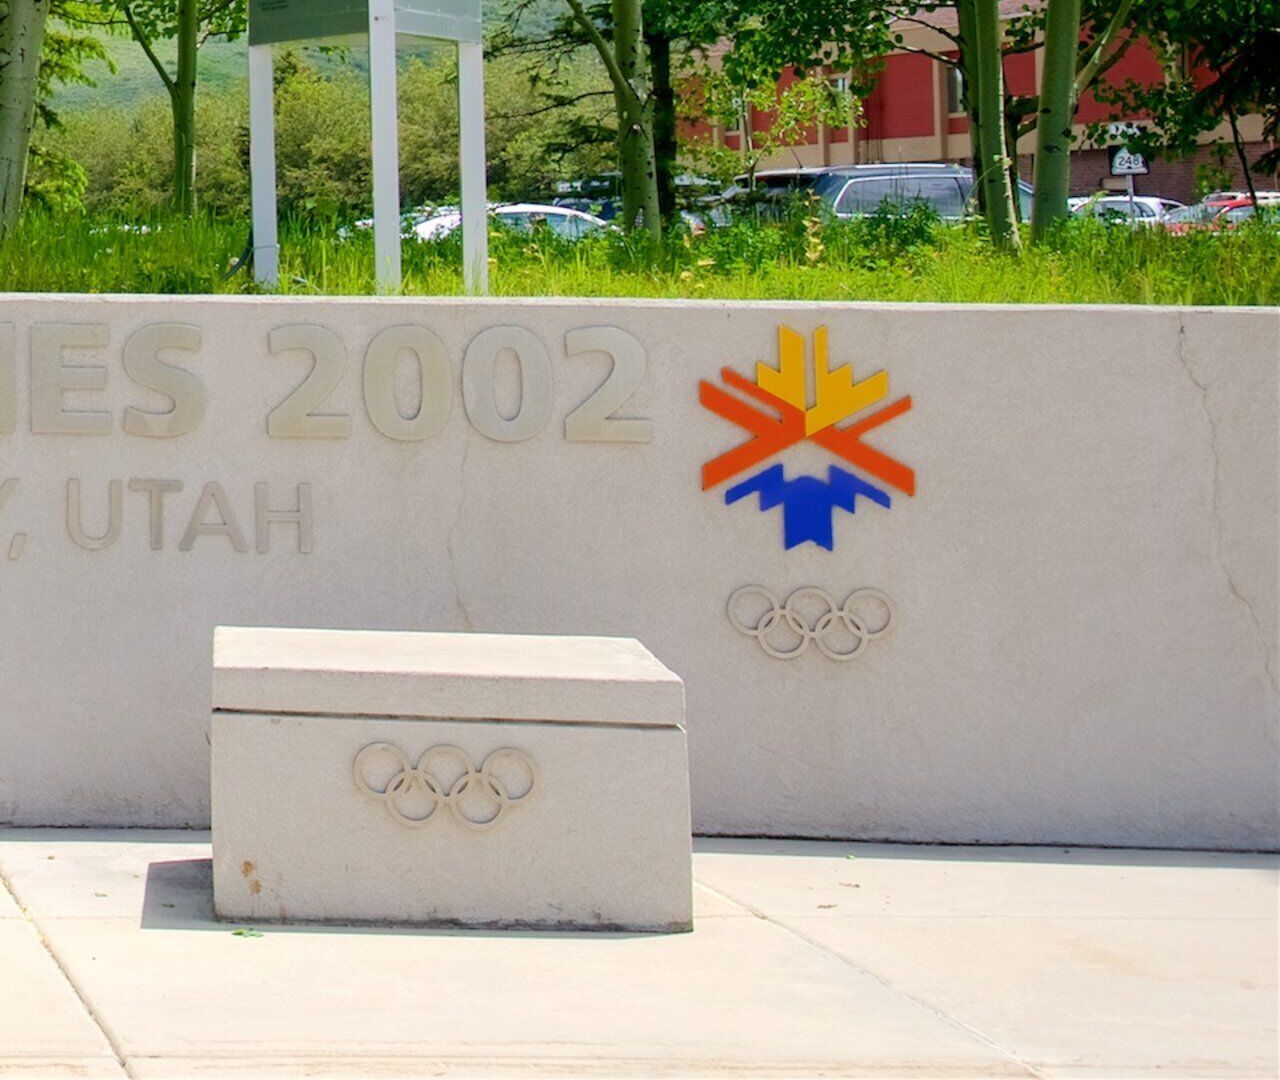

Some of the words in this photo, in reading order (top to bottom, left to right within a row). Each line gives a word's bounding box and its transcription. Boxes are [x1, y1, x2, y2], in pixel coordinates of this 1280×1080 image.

[1118, 155, 1140, 167] 248
[267, 324, 652, 444] 2002
[65, 478, 313, 554] UTAH
